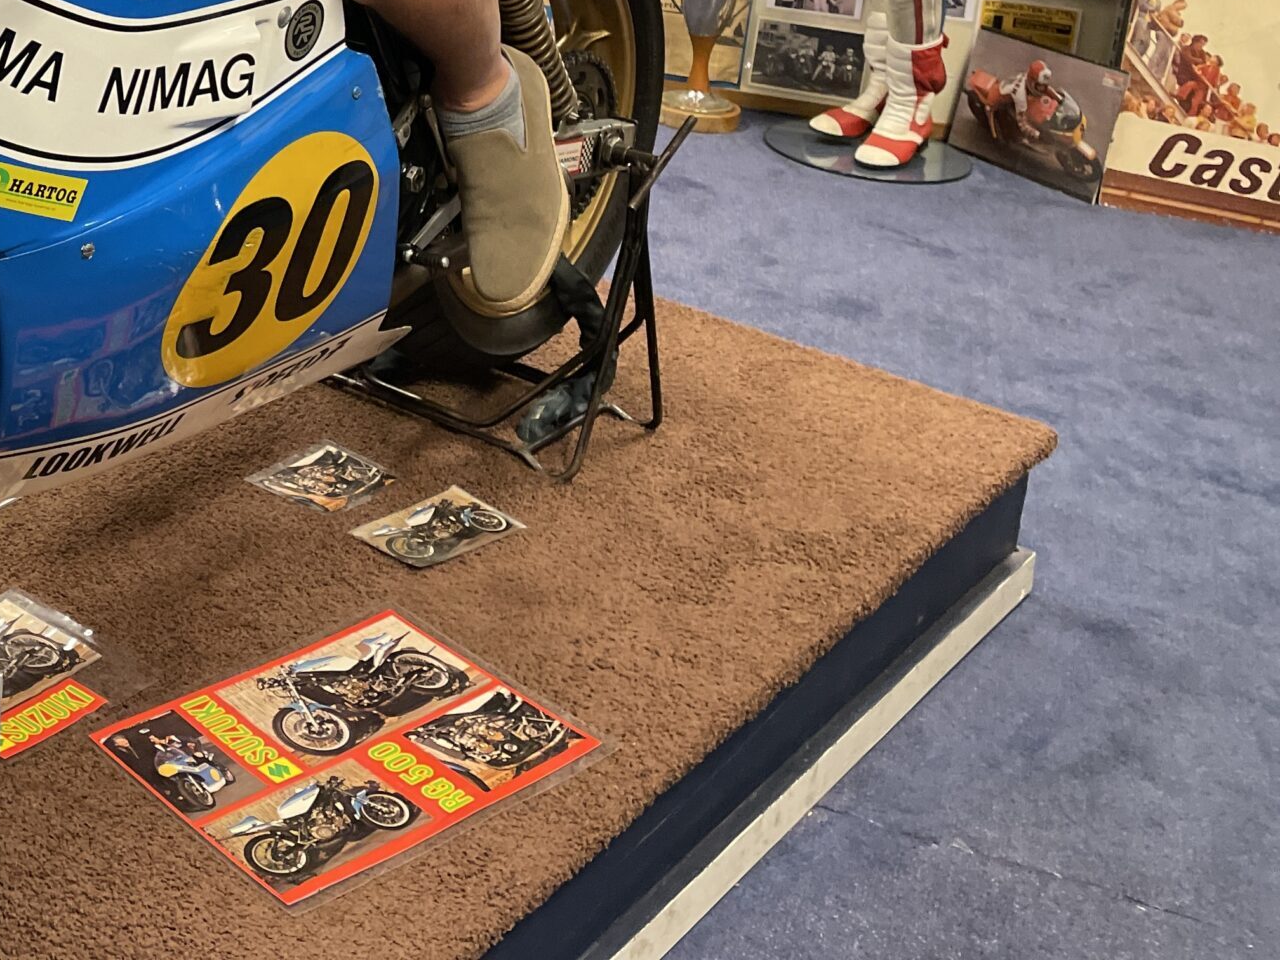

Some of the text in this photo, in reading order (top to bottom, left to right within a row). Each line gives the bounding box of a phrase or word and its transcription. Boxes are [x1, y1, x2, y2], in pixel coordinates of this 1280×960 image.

[97, 53, 255, 115] NIMAG
[8, 178, 78, 204] HARTOG
[176, 159, 375, 359] 30
[23, 413, 185, 480] LOOKWELL
[0, 685, 96, 743] SUZUKI
[180, 695, 276, 766] SUZUKI
[368, 741, 474, 813] RG 500
